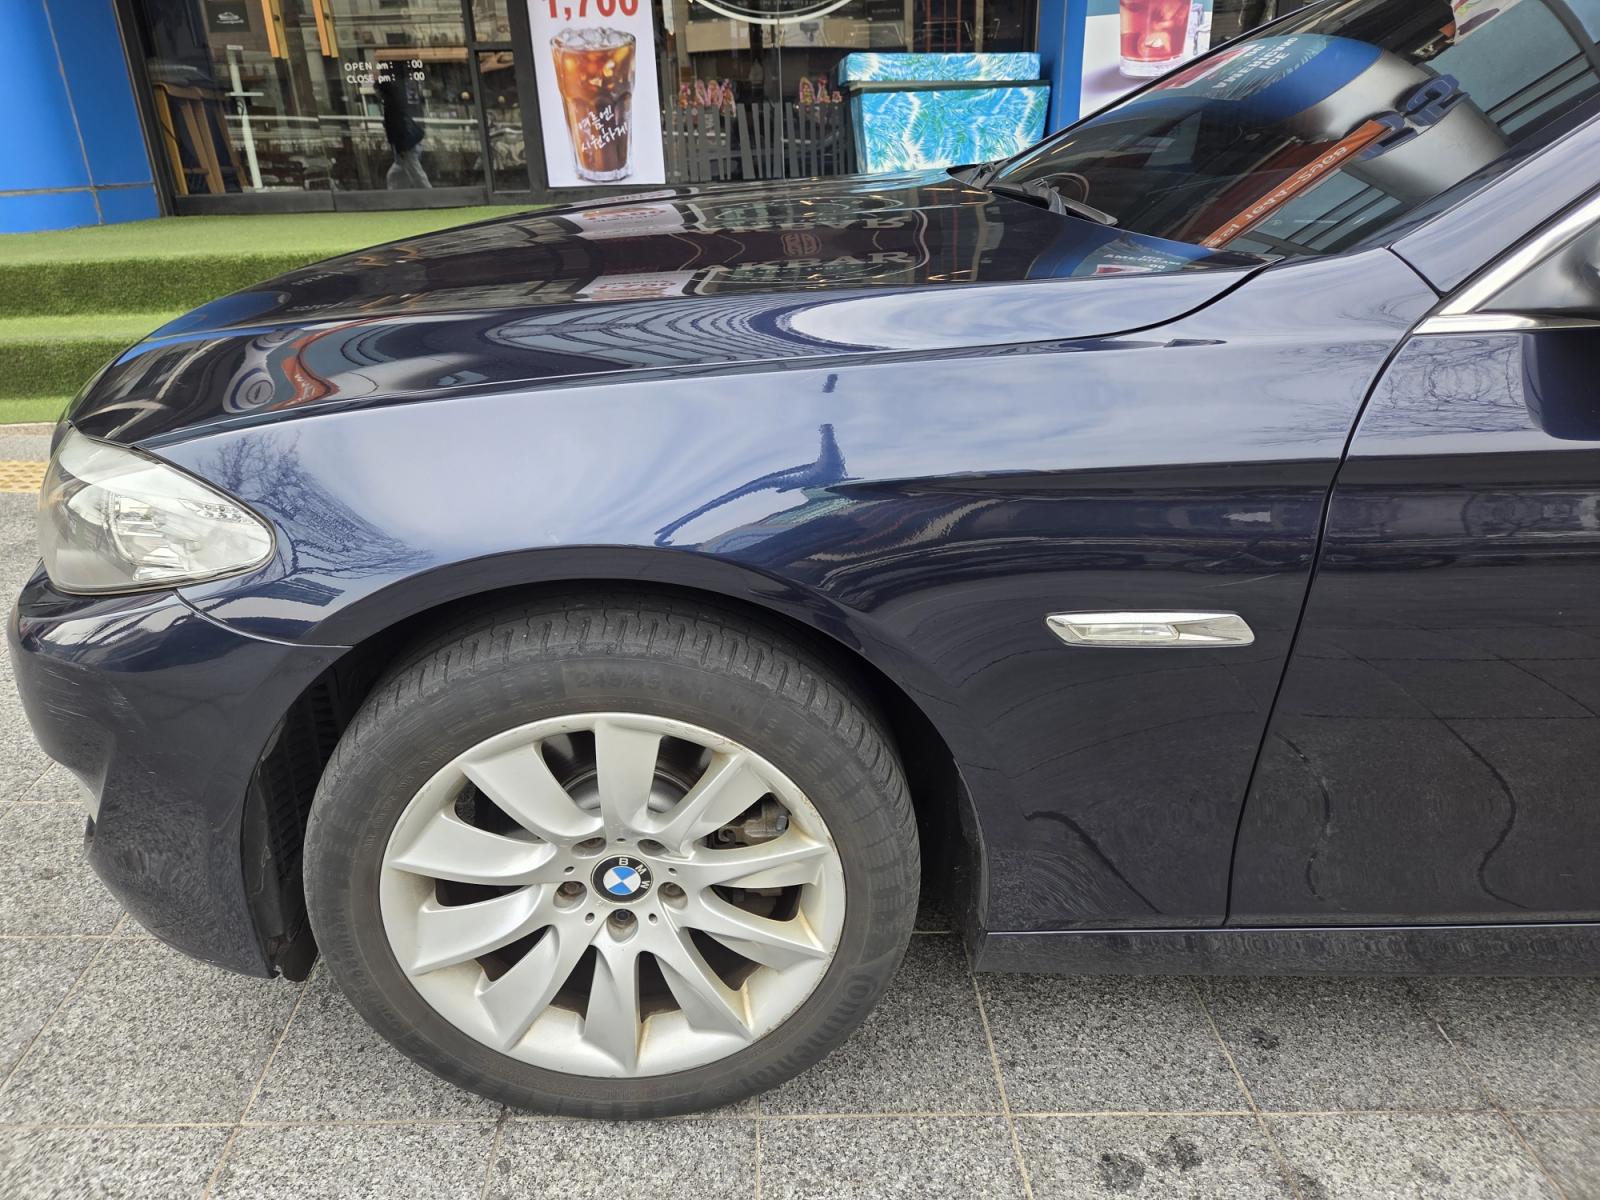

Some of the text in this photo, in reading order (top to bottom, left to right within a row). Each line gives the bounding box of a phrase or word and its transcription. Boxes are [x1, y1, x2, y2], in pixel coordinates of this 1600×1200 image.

[344, 62, 372, 72] OPEN
[346, 74, 375, 84] CLOSE
[618, 857, 651, 889] BMW
